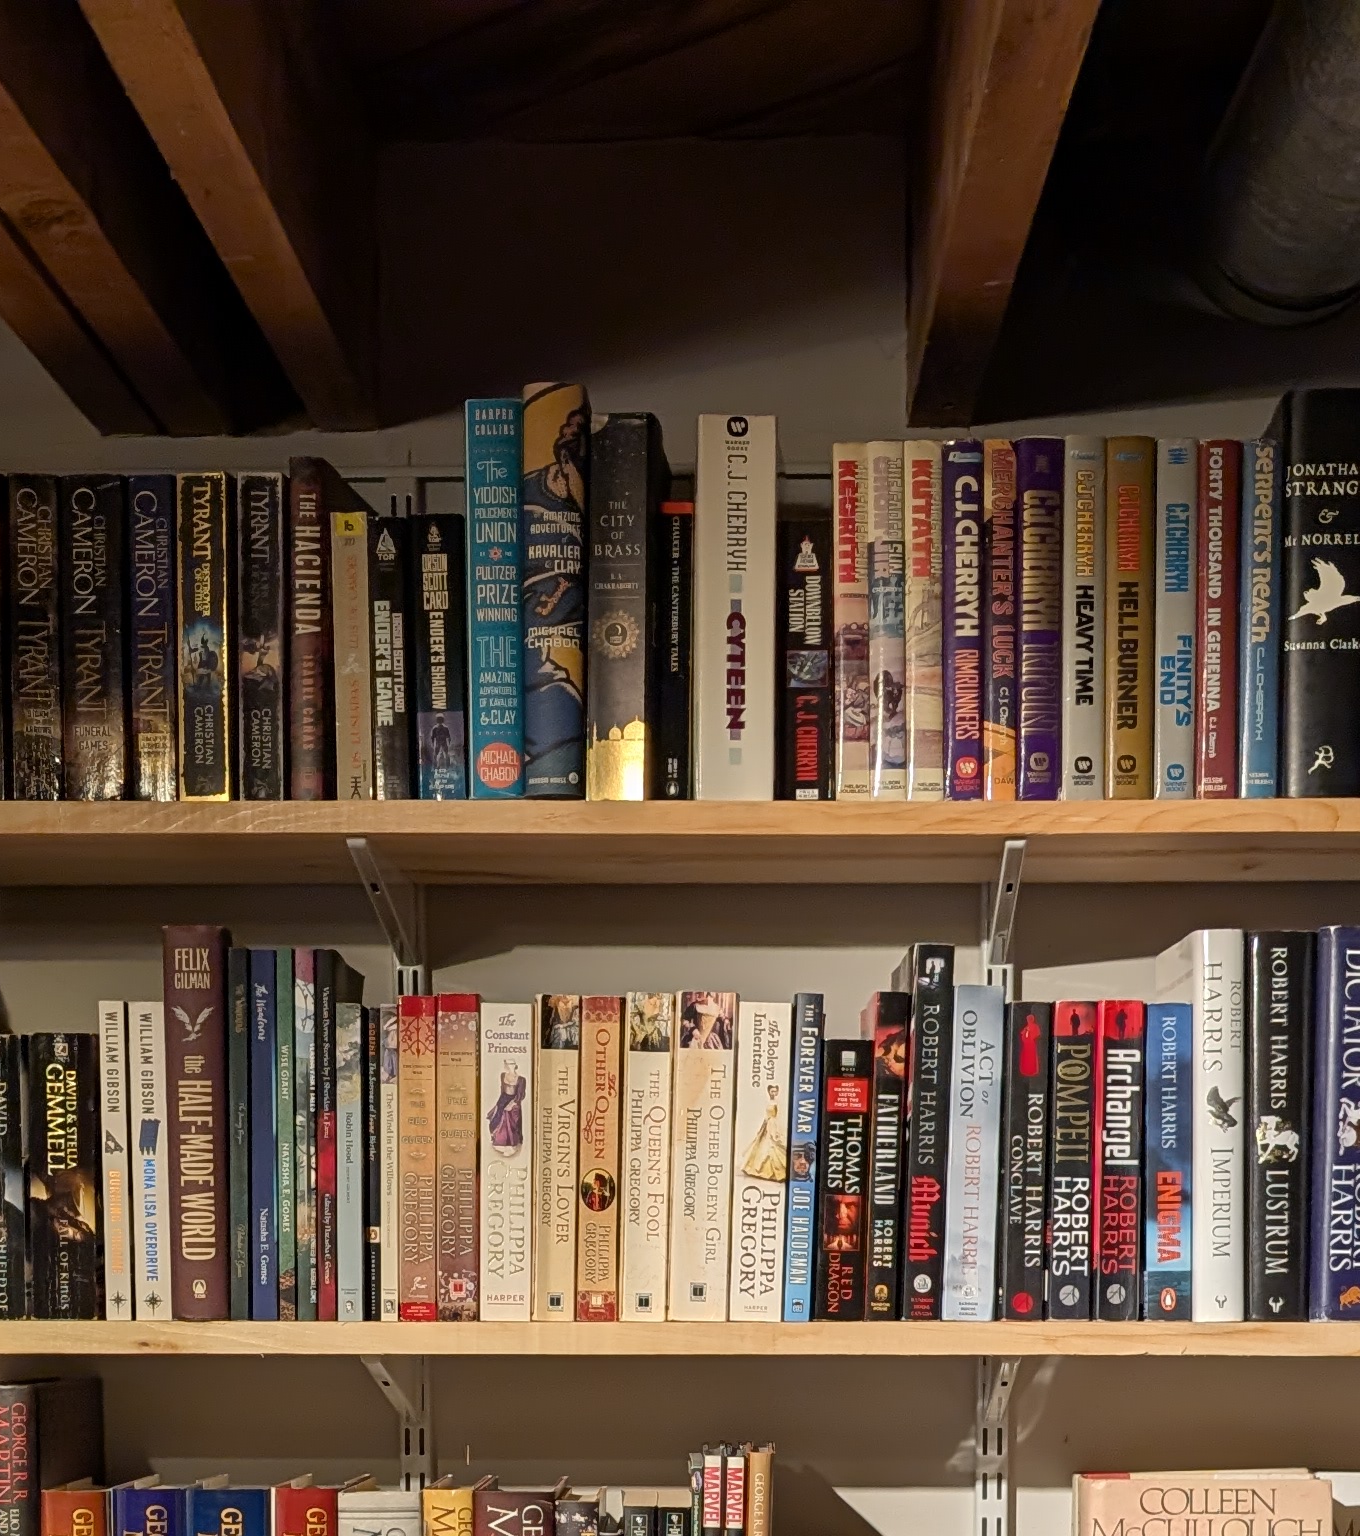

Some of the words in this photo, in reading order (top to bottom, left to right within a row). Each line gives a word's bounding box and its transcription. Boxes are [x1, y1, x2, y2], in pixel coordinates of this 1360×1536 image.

[299, 493, 317, 520] THE
[600, 514, 635, 527] CITY
[1318, 509, 1340, 523] &
[594, 544, 640, 556] BRASS
[611, 531, 624, 540] OF
[294, 527, 321, 635] HACIENDA
[1116, 582, 1138, 730] HELLBURNER
[1284, 640, 1326, 649] Susanna
[726, 611, 746, 729] CYTEEN
[956, 648, 979, 740] RIMRUNNERS
[174, 948, 210, 971] FELIX
[174, 971, 210, 990] GILMAN
[183, 1054, 201, 1074] the
[1055, 1043, 1090, 1164] POMPEII
[1105, 1049, 1139, 1167] Archangel
[177, 1079, 214, 1180] HALF-MADE
[180, 1186, 216, 1261] WORLD
[727, 1467, 744, 1528] MARVEL
